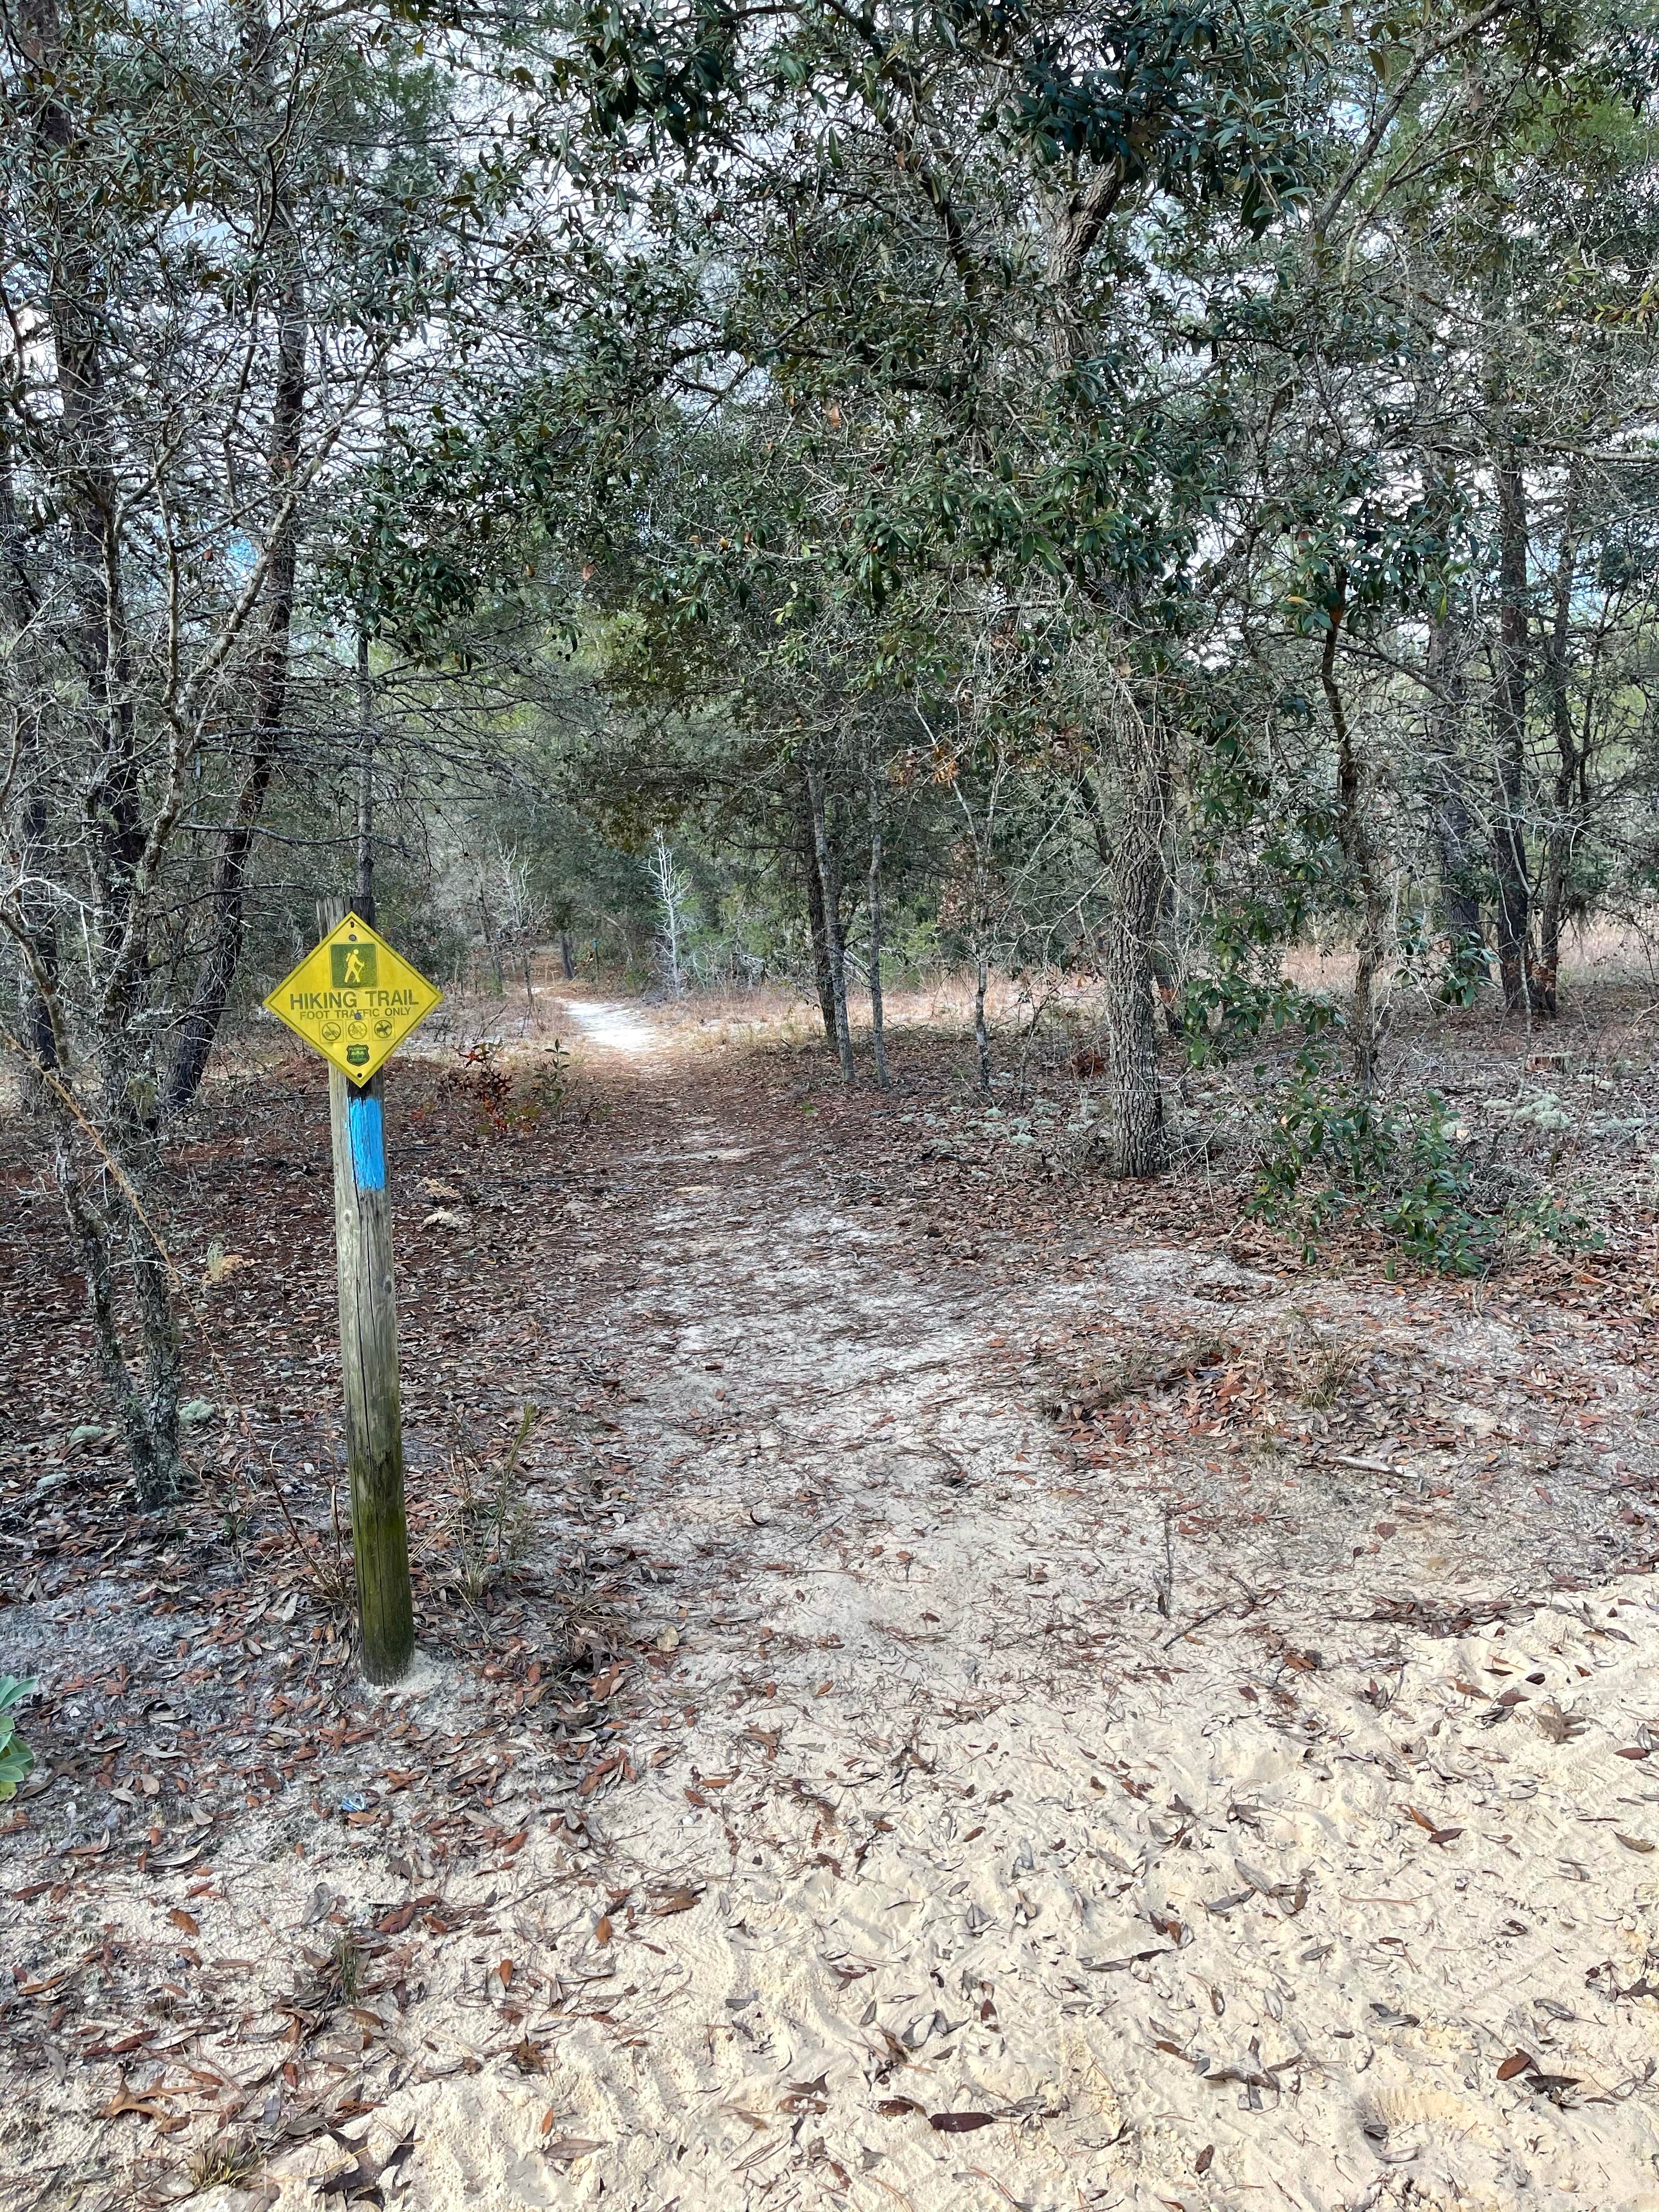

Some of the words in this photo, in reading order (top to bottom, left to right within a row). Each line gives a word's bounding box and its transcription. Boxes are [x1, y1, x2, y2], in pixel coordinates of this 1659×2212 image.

[290, 991, 357, 1009] HIKING
[365, 990, 419, 1007] TRAIL
[300, 1011, 330, 1019] FOOT
[385, 1007, 410, 1017] ONLY
